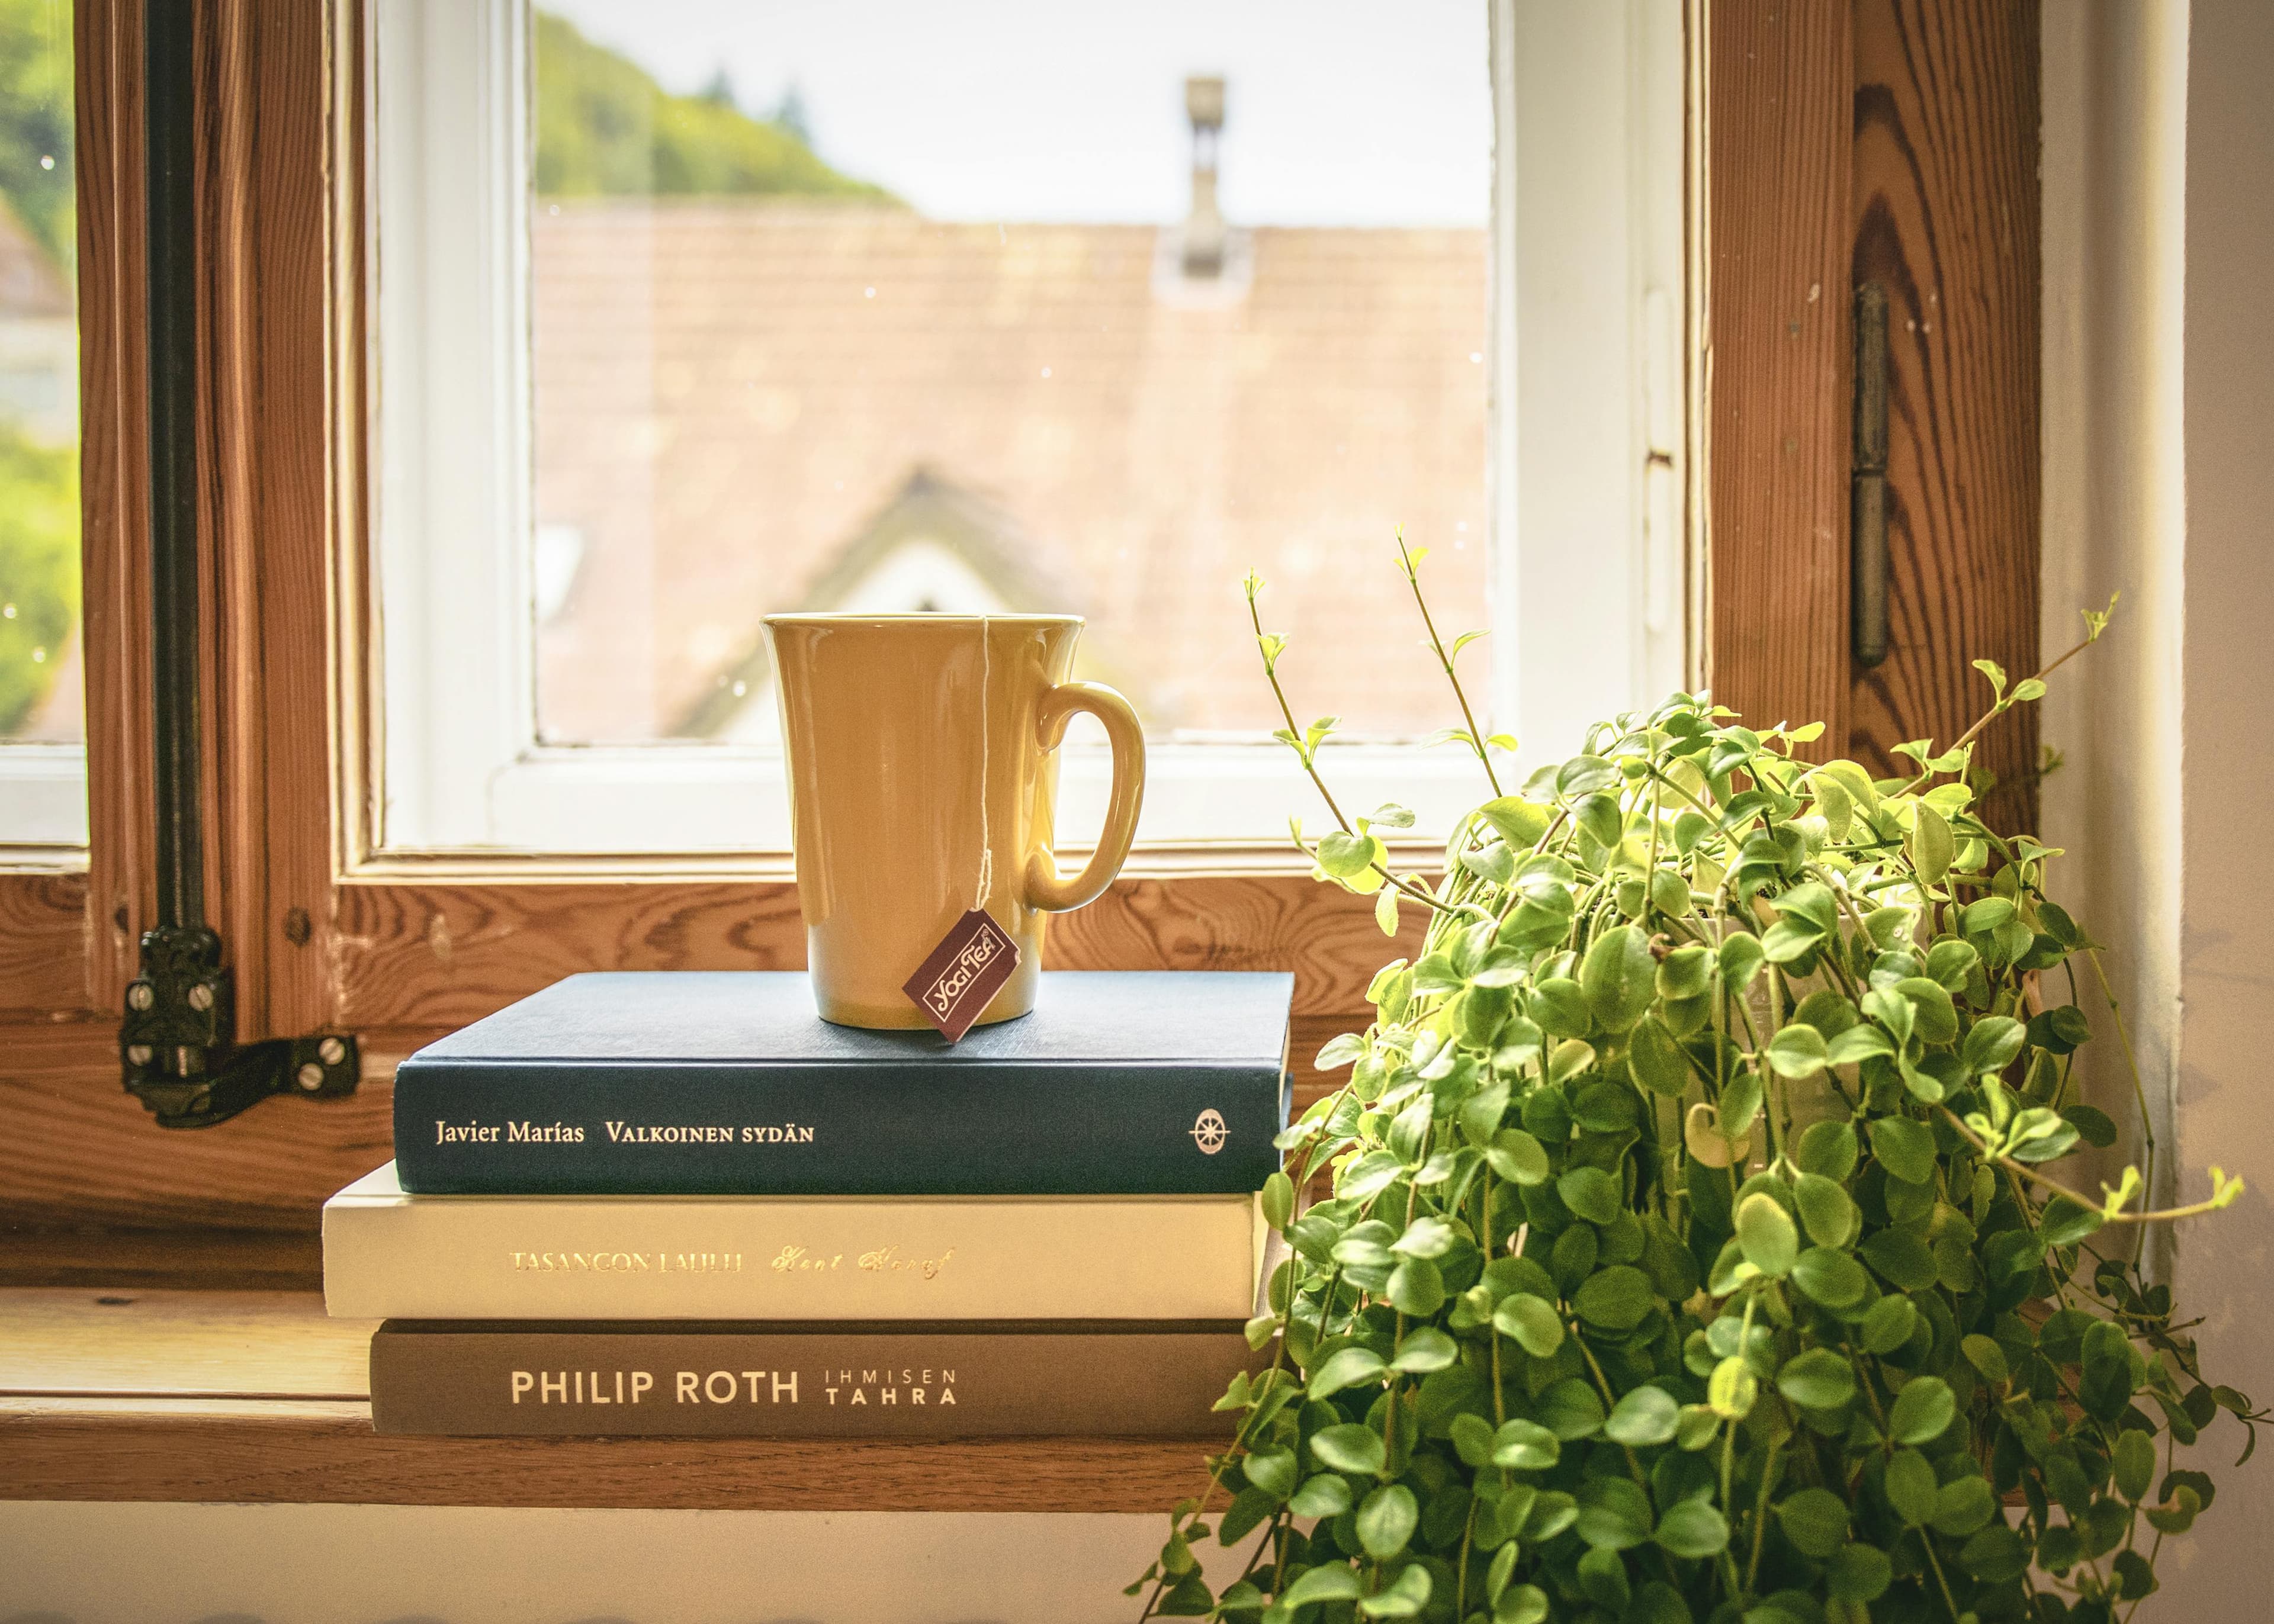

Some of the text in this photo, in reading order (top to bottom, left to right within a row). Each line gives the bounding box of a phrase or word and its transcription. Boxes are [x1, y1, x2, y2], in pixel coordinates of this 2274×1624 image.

[933, 966, 972, 1012] YOGI
[435, 1120, 815, 1145] Javier Marías VALKOINEN SYDÄN
[509, 1252, 651, 1273] TASANGON
[658, 1252, 742, 1273] LAULU
[512, 1371, 798, 1404] PHILIP ROTH
[826, 1369, 955, 1384] IHMISEN
[825, 1388, 956, 1405] TAHRA
